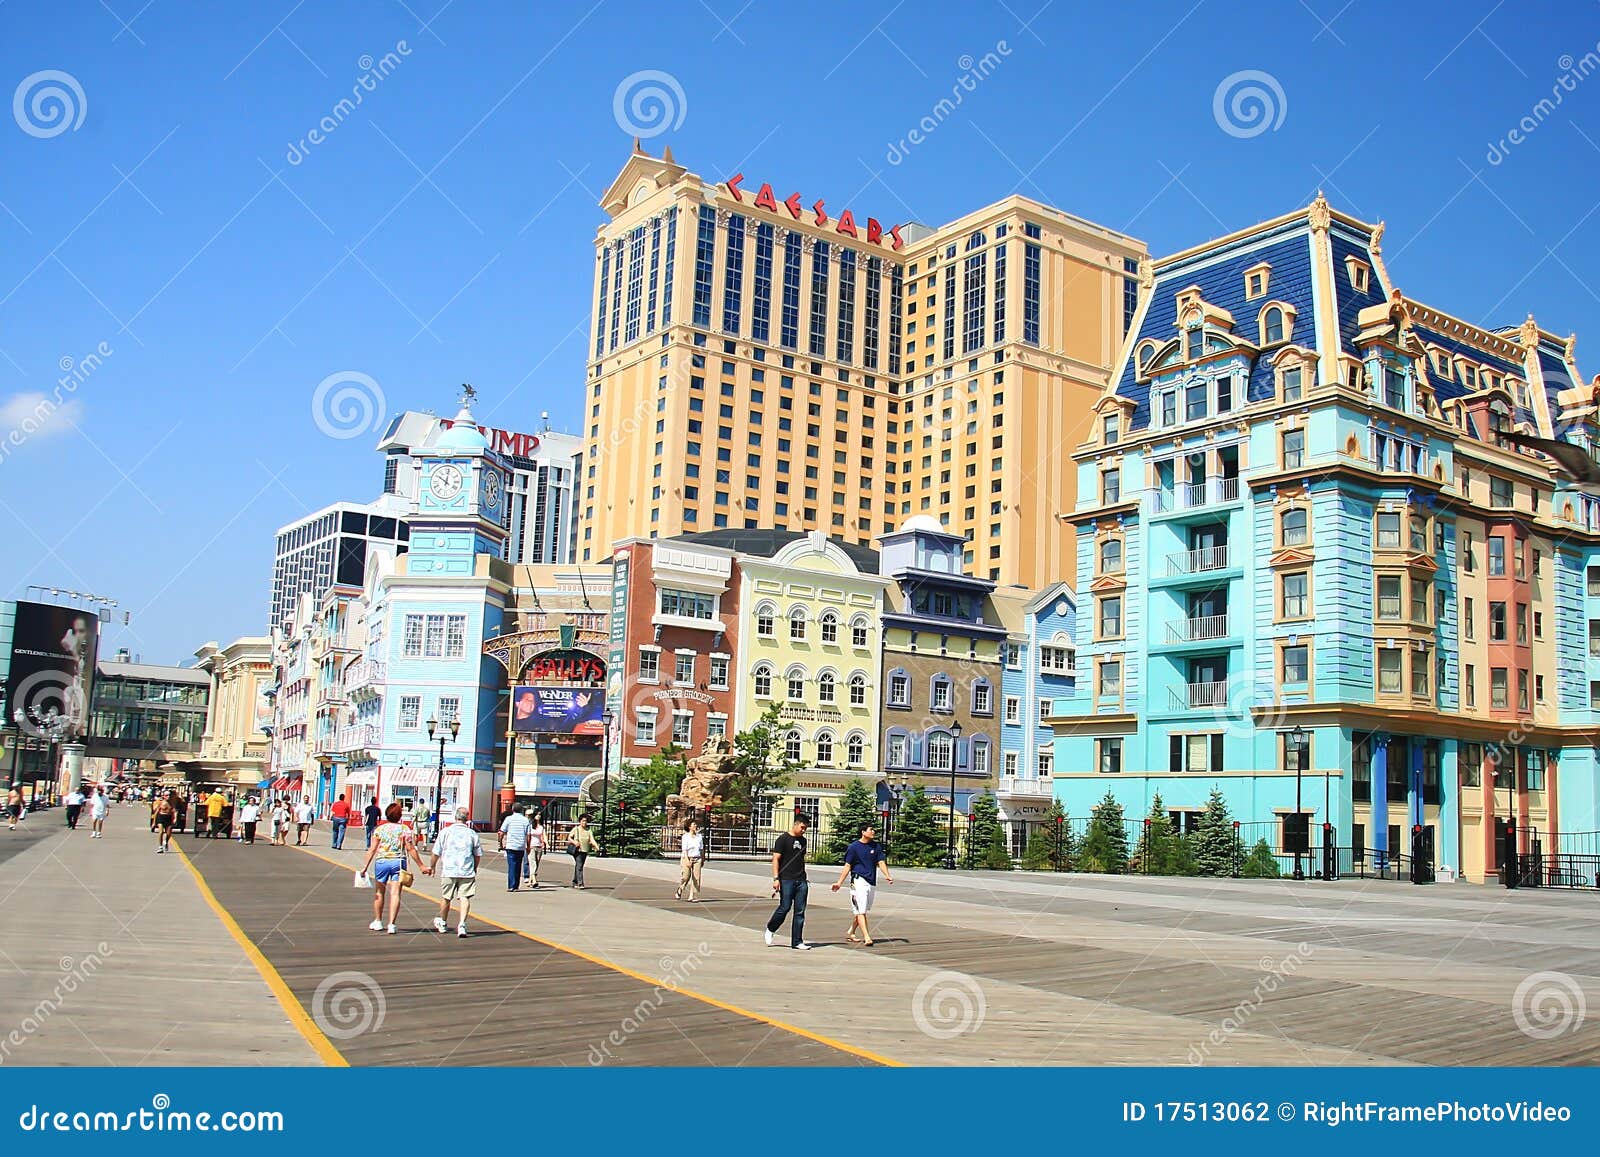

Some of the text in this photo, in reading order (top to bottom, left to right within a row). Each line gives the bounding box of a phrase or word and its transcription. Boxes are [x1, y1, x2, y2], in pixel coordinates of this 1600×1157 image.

[726, 173, 904, 250] CAESARS
[538, 689, 573, 700] WONDER
[816, 709, 842, 724] WORKS
[797, 781, 846, 790] UMBRELLA
